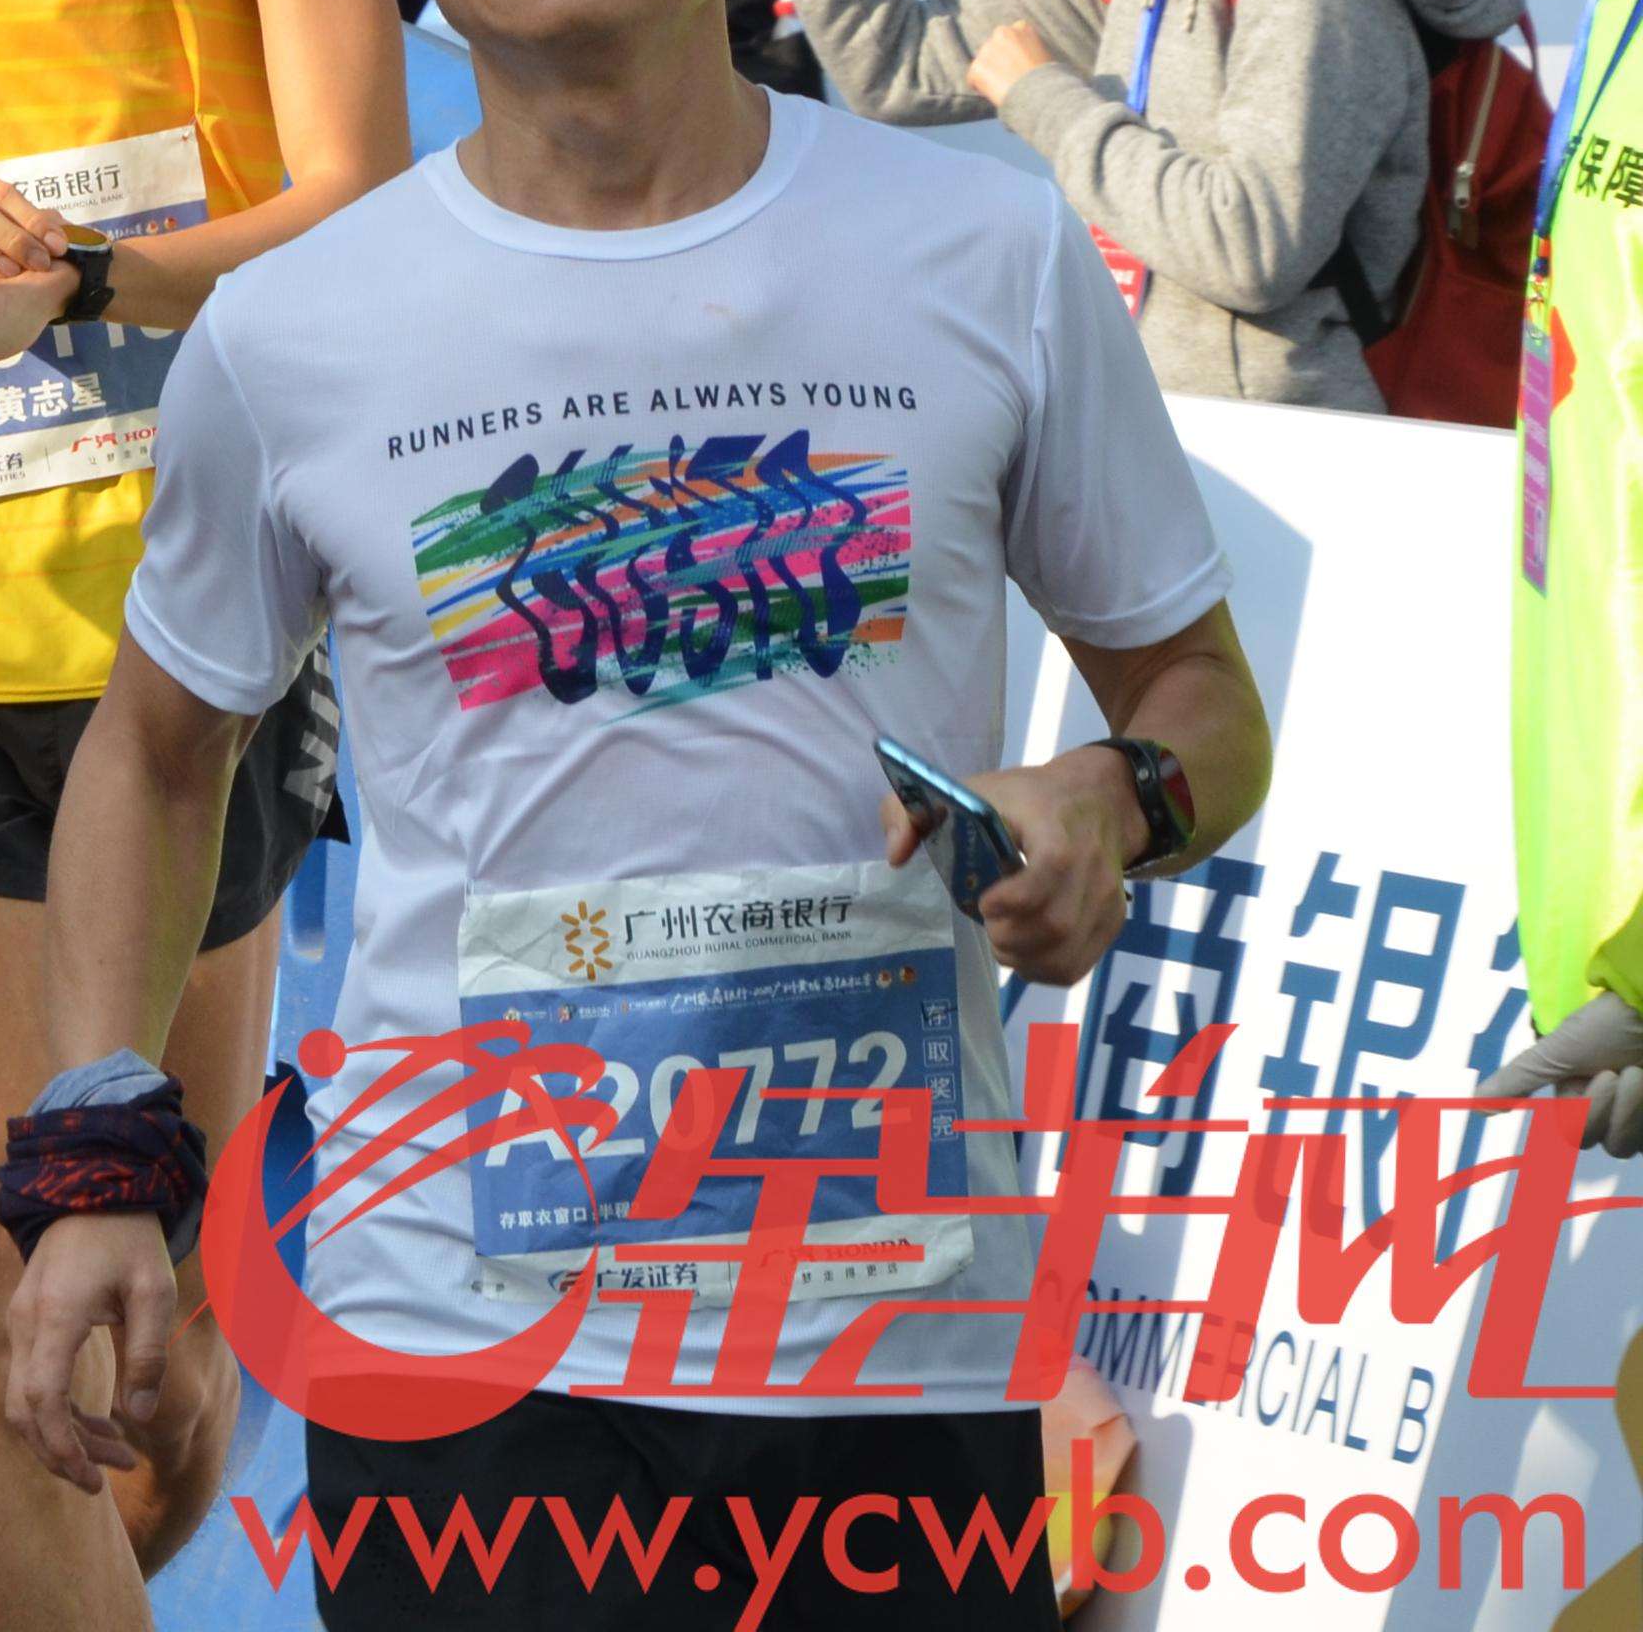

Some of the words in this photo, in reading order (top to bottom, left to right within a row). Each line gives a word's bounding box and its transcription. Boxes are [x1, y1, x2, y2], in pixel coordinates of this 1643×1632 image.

[1575, 135, 1643, 208] 保障
[71, 433, 118, 452] 广汽
[387, 403, 543, 459] RUNNERS
[562, 392, 630, 420] ARE
[650, 383, 787, 412] ALWAYS
[801, 382, 918, 411] YOUNG
[625, 895, 853, 945] 广州农商银行
[627, 944, 702, 962] GUANGZHOU
[705, 940, 741, 955] RURAL
[744, 933, 817, 951] COMMERCIAL
[820, 930, 852, 944] BANK
[999, 852, 1529, 1267] 商银
[485, 1031, 912, 1168] A20772
[499, 1200, 639, 1231] 存取衣窗口:半程
[597, 1262, 698, 1290] 广发证券
